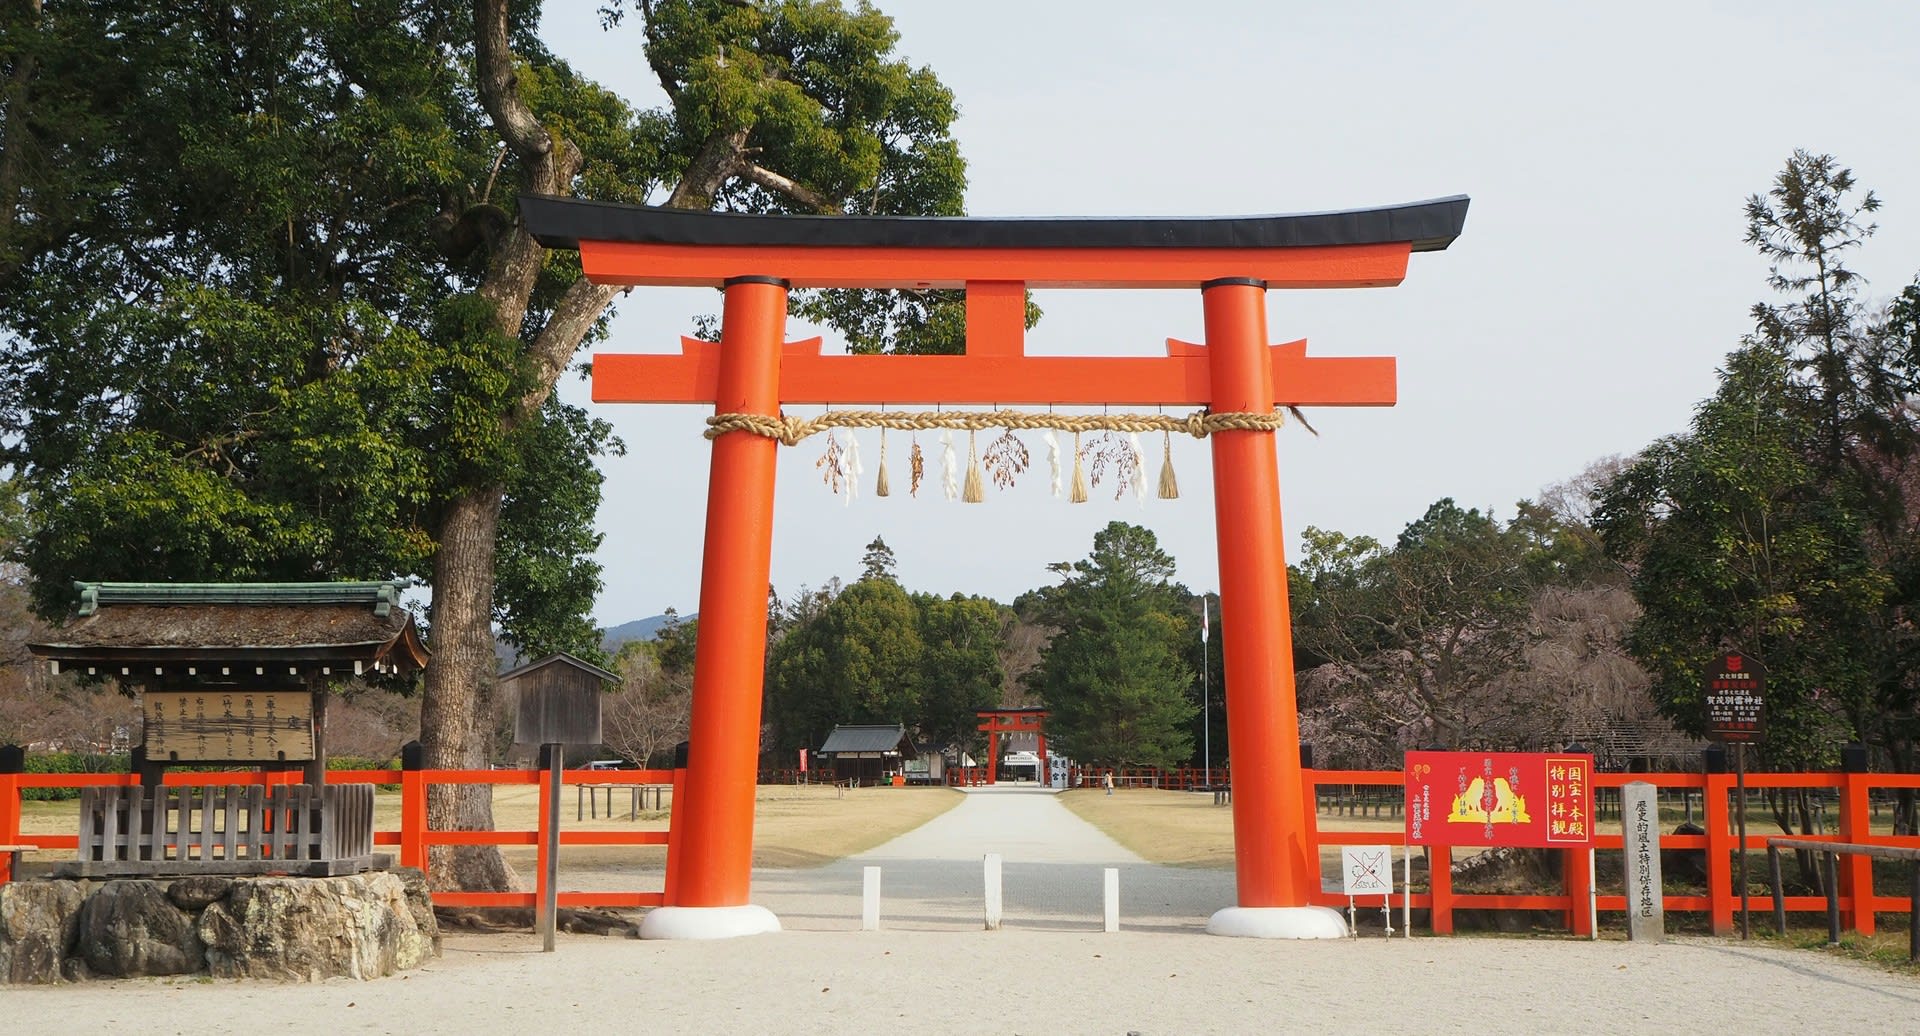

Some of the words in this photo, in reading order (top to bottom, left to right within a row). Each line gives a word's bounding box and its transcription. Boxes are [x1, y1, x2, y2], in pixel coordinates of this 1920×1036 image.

[1706, 695, 1764, 705] 賀茂別雷神社
[1549, 765, 1568, 836] 特別拝観
[1567, 767, 1585, 837] 国宝・本殿
[1635, 800, 1654, 918] 歴史的風土特別保存地区
